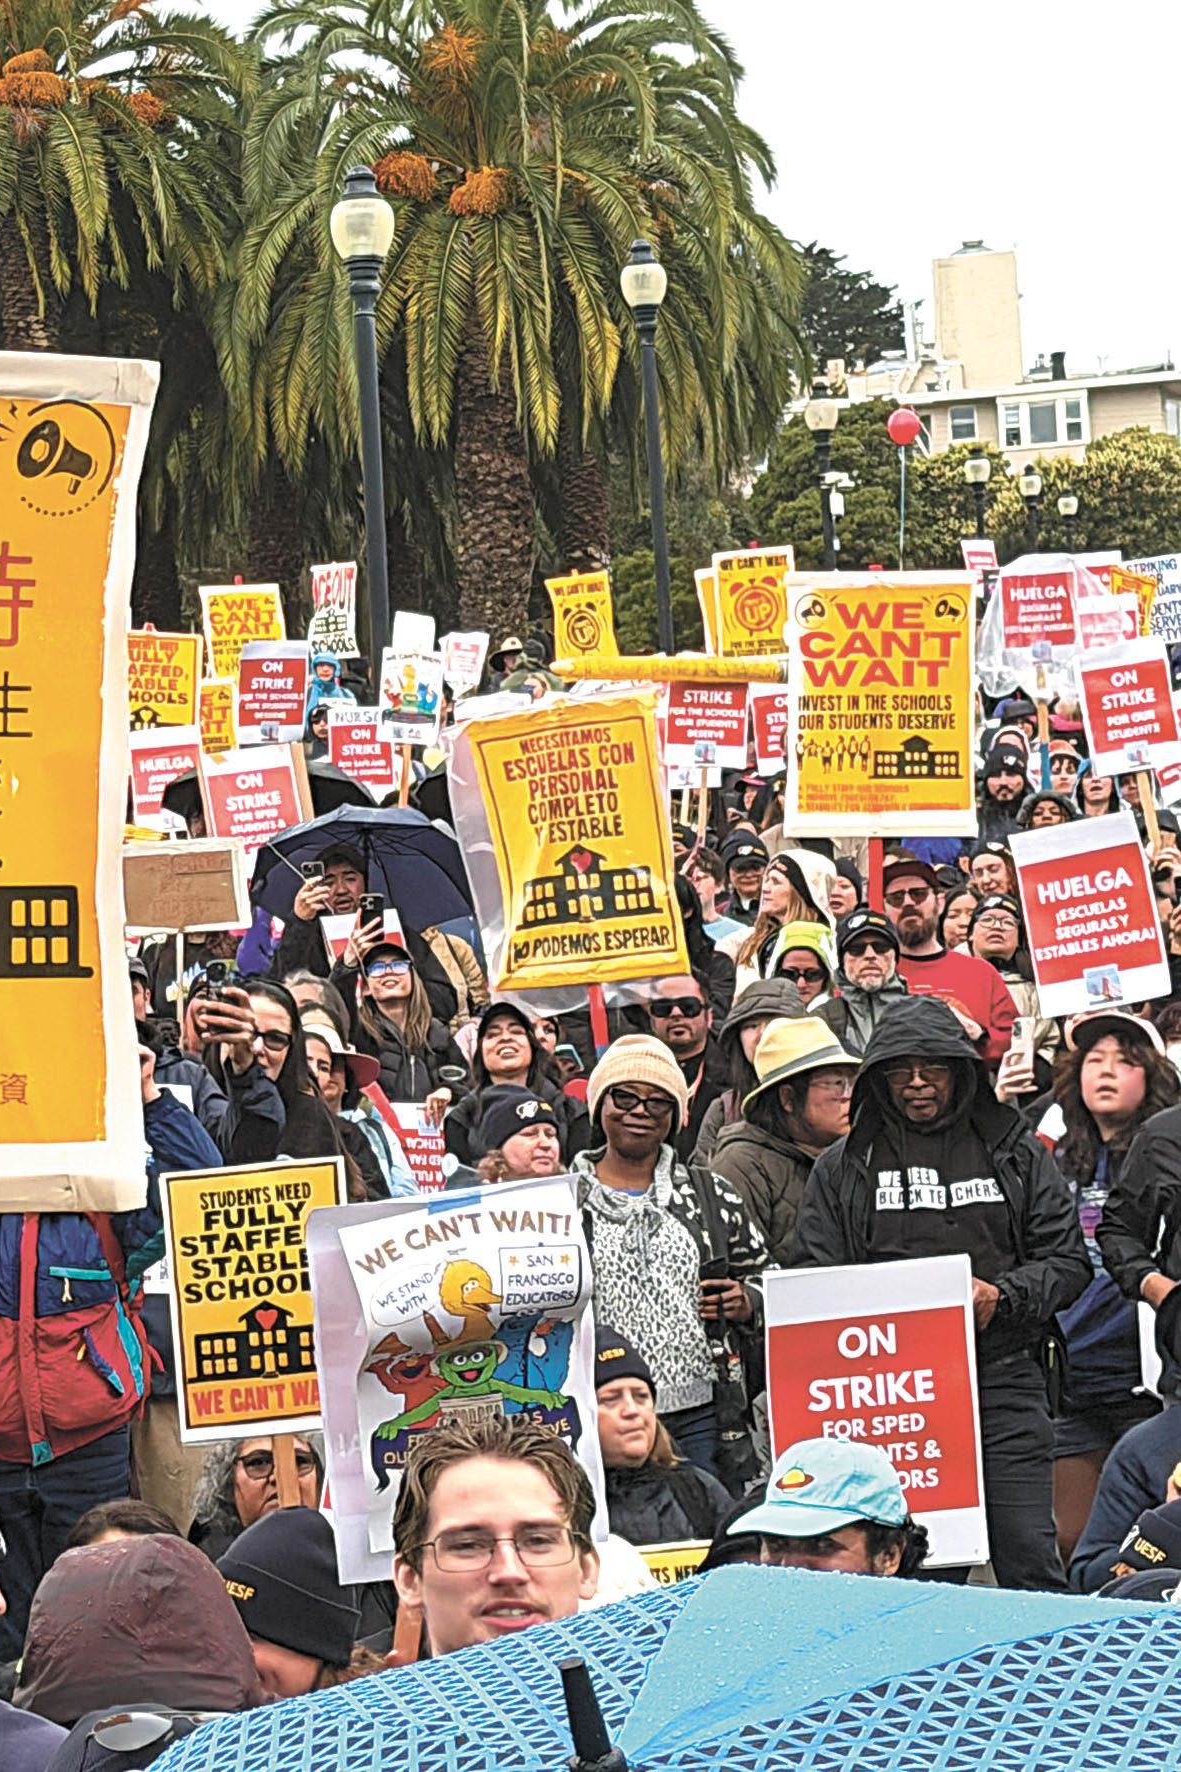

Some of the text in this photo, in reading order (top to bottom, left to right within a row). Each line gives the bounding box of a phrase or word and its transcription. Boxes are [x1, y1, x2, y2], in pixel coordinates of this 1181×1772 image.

[223, 598, 261, 611] WE
[1010, 585, 1067, 602] HUELGA
[835, 602, 925, 629] WE
[211, 623, 273, 637] WAIT
[127, 648, 176, 664] ULLY
[262, 660, 283, 673] ON
[127, 664, 189, 679] AFFED,
[802, 660, 949, 688] WAIT
[1110, 669, 1139, 688] ON
[251, 677, 294, 690] STRIKE
[129, 691, 189, 705] HOOLS
[683, 690, 732, 704] STRIKE
[798, 695, 952, 711] INVEST IN THE SCHOOLS
[1102, 688, 1156, 711] STRIKE
[798, 713, 956, 731] OUR STUDENTS DESERVE
[1107, 710, 1156, 727] FOR OUR
[351, 728, 371, 742] ON
[519, 727, 612, 753] NECESITAMOS
[1107, 722, 1161, 741] STUDENTS
[342, 743, 381, 756] STRIKE
[140, 756, 195, 772] HUELGA
[503, 742, 636, 782] ESCUELAS CON
[235, 773, 263, 790] ON
[528, 770, 618, 800] PERSONAL
[226, 791, 281, 811] STRIKE
[527, 792, 619, 824] COMPLETO
[534, 814, 624, 848] Y ESTABLE
[1036, 866, 1133, 905] HUELGA
[1055, 913, 1129, 941] SEGURAS Y
[532, 933, 602, 960] PODEMOS
[605, 925, 670, 950] ESPERAR
[1036, 938, 1099, 961] ESTABLES
[878, 1170, 901, 1187] WE
[200, 1182, 312, 1211] STUDENTS NEED
[929, 1181, 1000, 1205] TECHERS
[203, 1201, 307, 1232] FULLY
[180, 1225, 305, 1257] STAFFE
[355, 1209, 572, 1275] WE CAN'T WAIT!
[526, 1253, 554, 1268] SAN
[376, 1271, 434, 1309] WE STAND
[508, 1273, 575, 1287] FRANCISCO
[396, 1292, 428, 1316] WITH
[837, 1322, 897, 1359] ON
[192, 1390, 224, 1418] WE
[228, 1384, 286, 1413] CAN'T
[807, 1369, 935, 1412] STRIKE
[822, 1412, 926, 1438] FOR SPED
[923, 1440, 942, 1459] &
[1134, 1537, 1166, 1564] UESF
